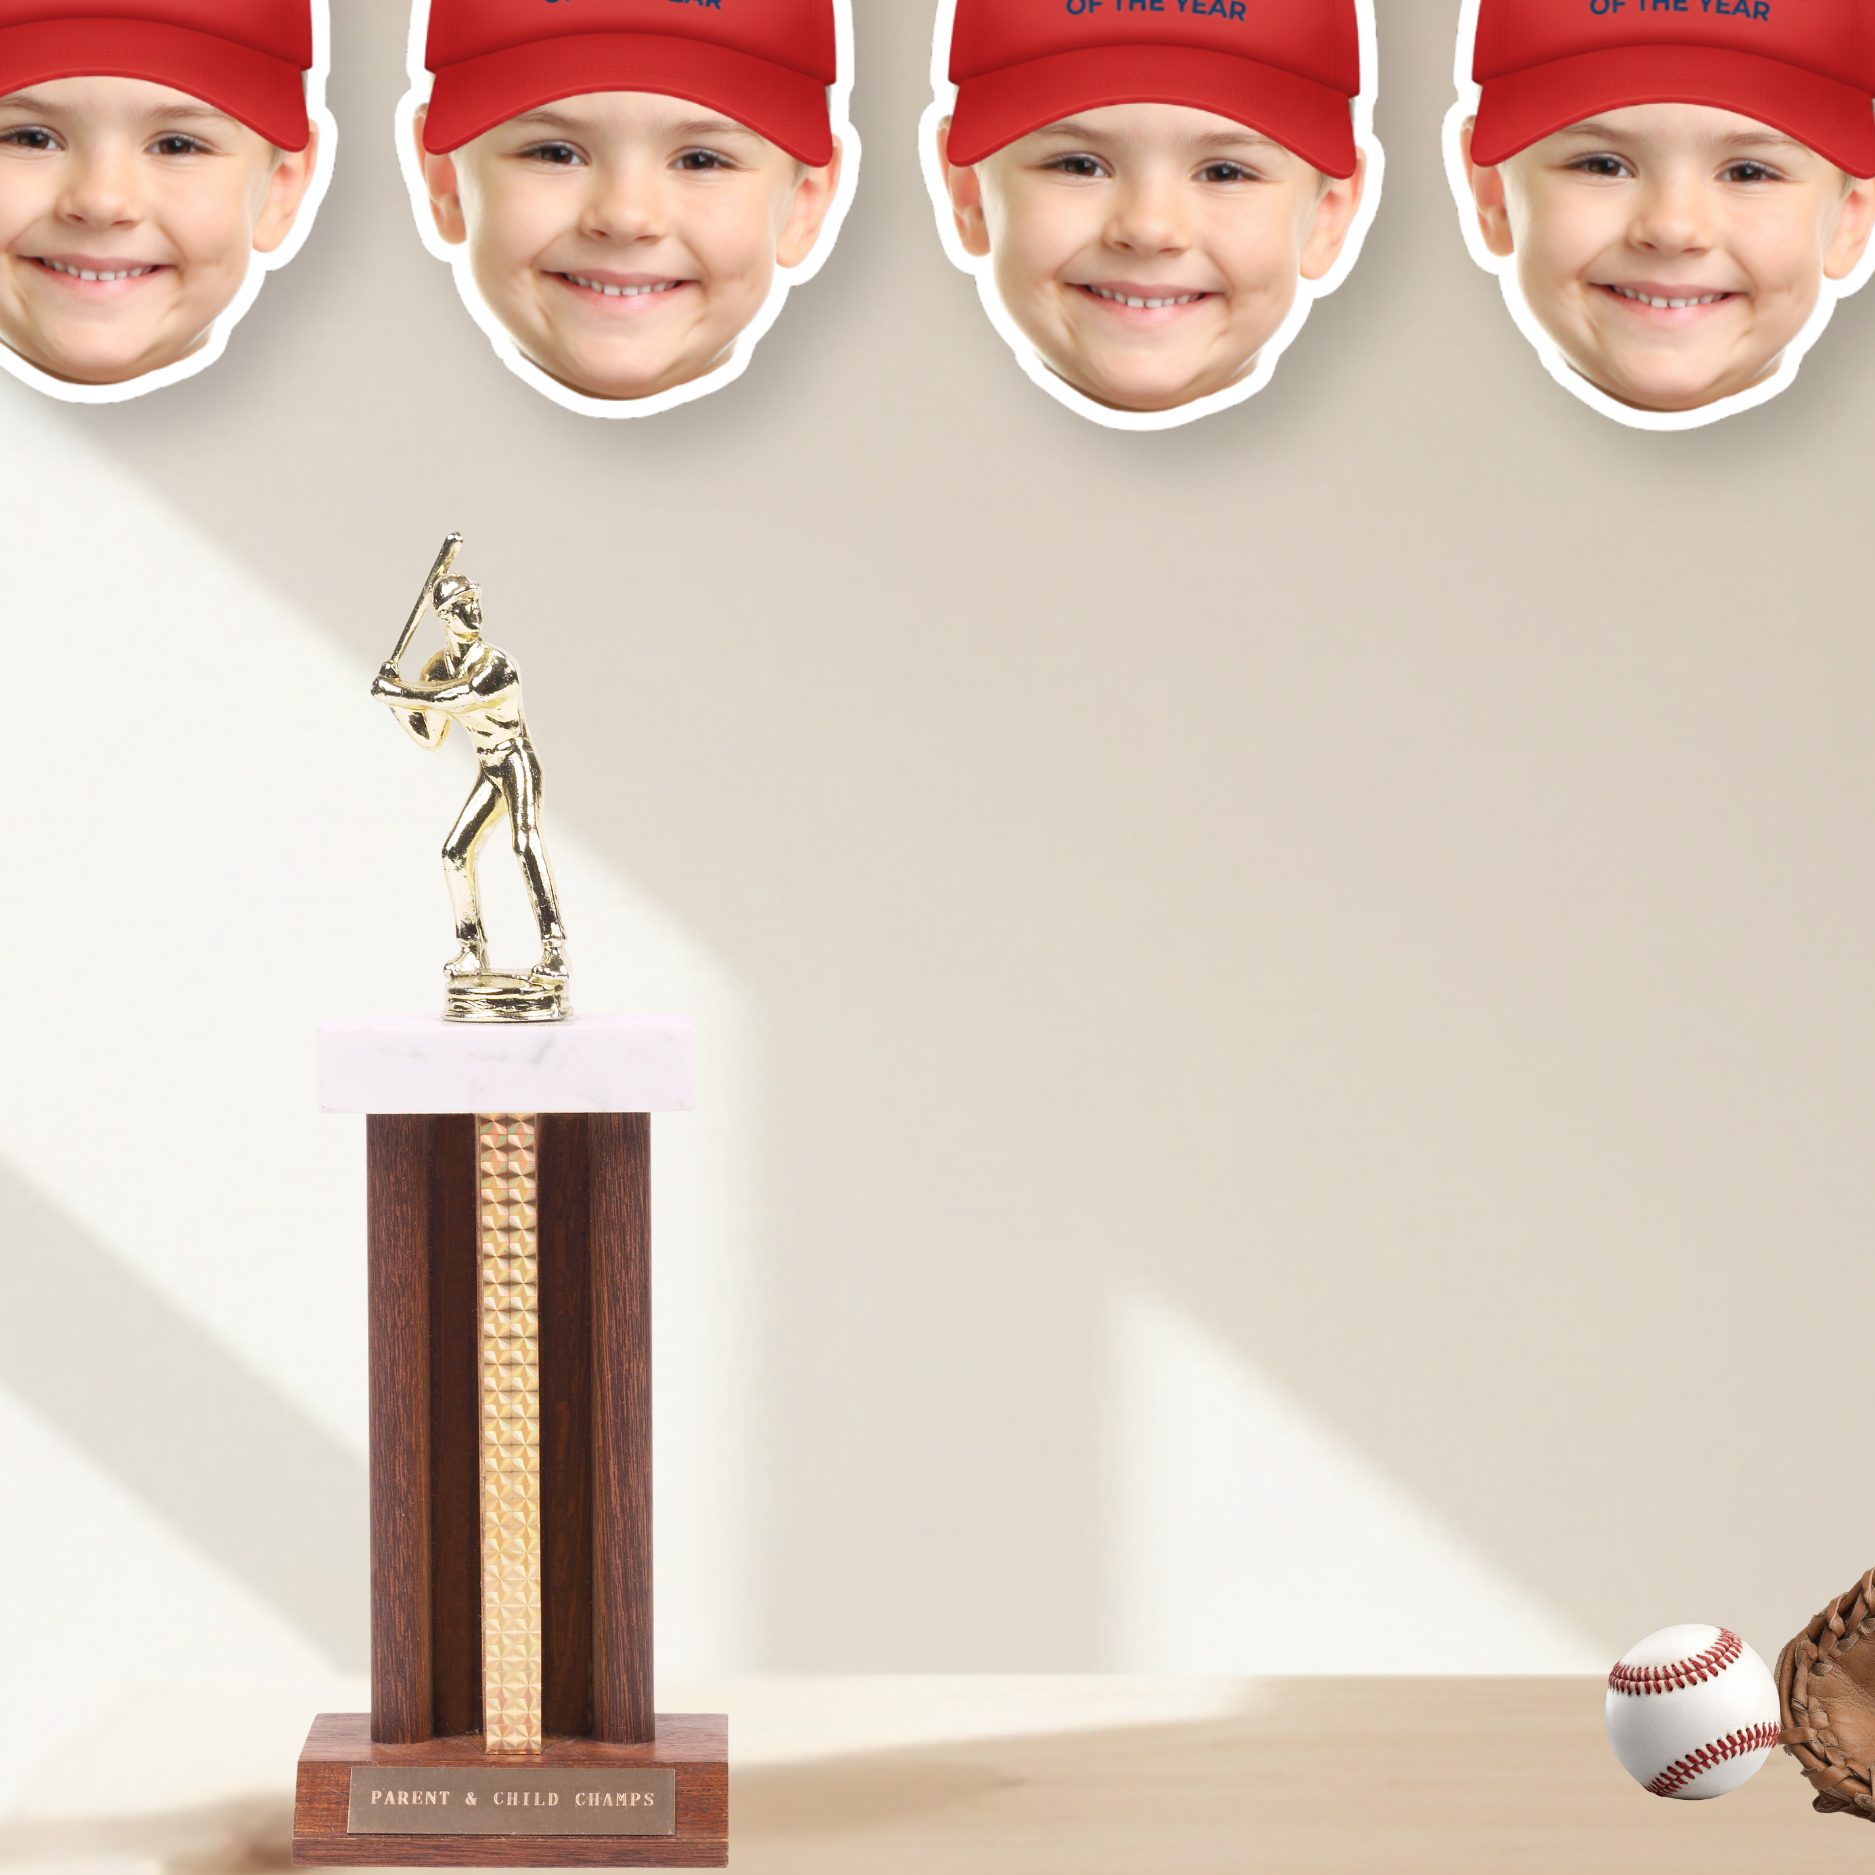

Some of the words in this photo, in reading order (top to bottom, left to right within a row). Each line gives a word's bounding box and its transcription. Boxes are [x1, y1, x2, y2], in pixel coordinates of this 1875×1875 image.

[370, 1790, 451, 1806] PARENT
[465, 1791, 479, 1806] &
[493, 1790, 560, 1807] CHILD
[575, 1790, 655, 1807] CHAMPS
